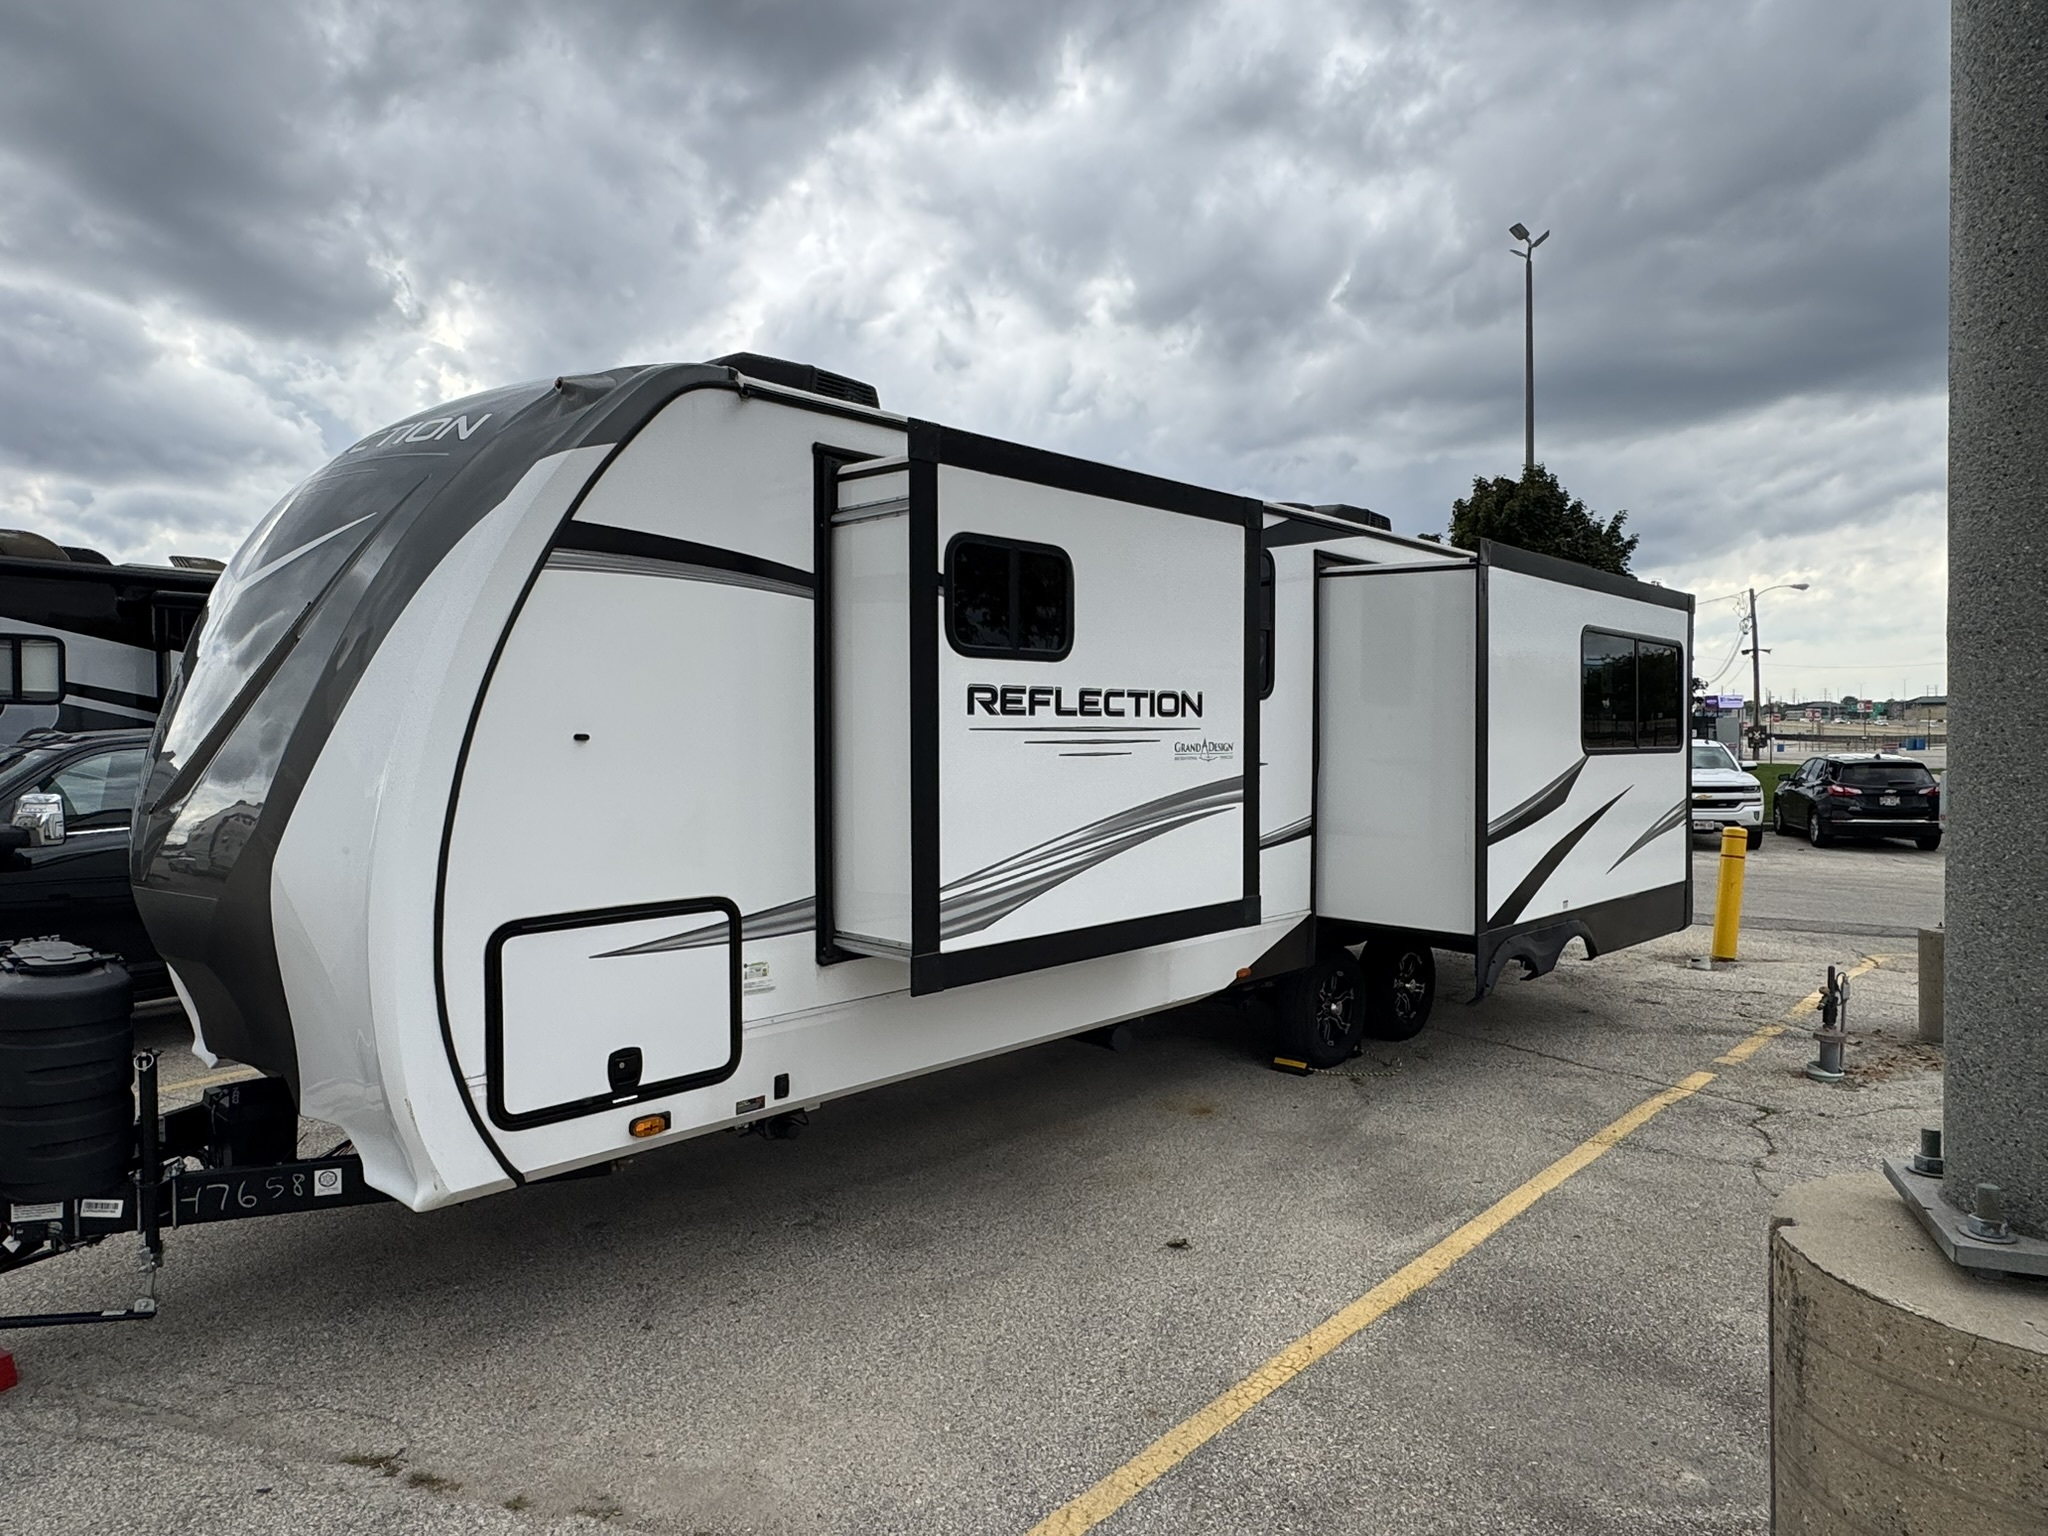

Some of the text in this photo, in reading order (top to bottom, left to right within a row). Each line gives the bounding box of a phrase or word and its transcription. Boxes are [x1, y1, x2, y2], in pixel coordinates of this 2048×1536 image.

[967, 683, 1203, 718] REFLECTION
[1174, 741, 1234, 752] GRAND DESIGN
